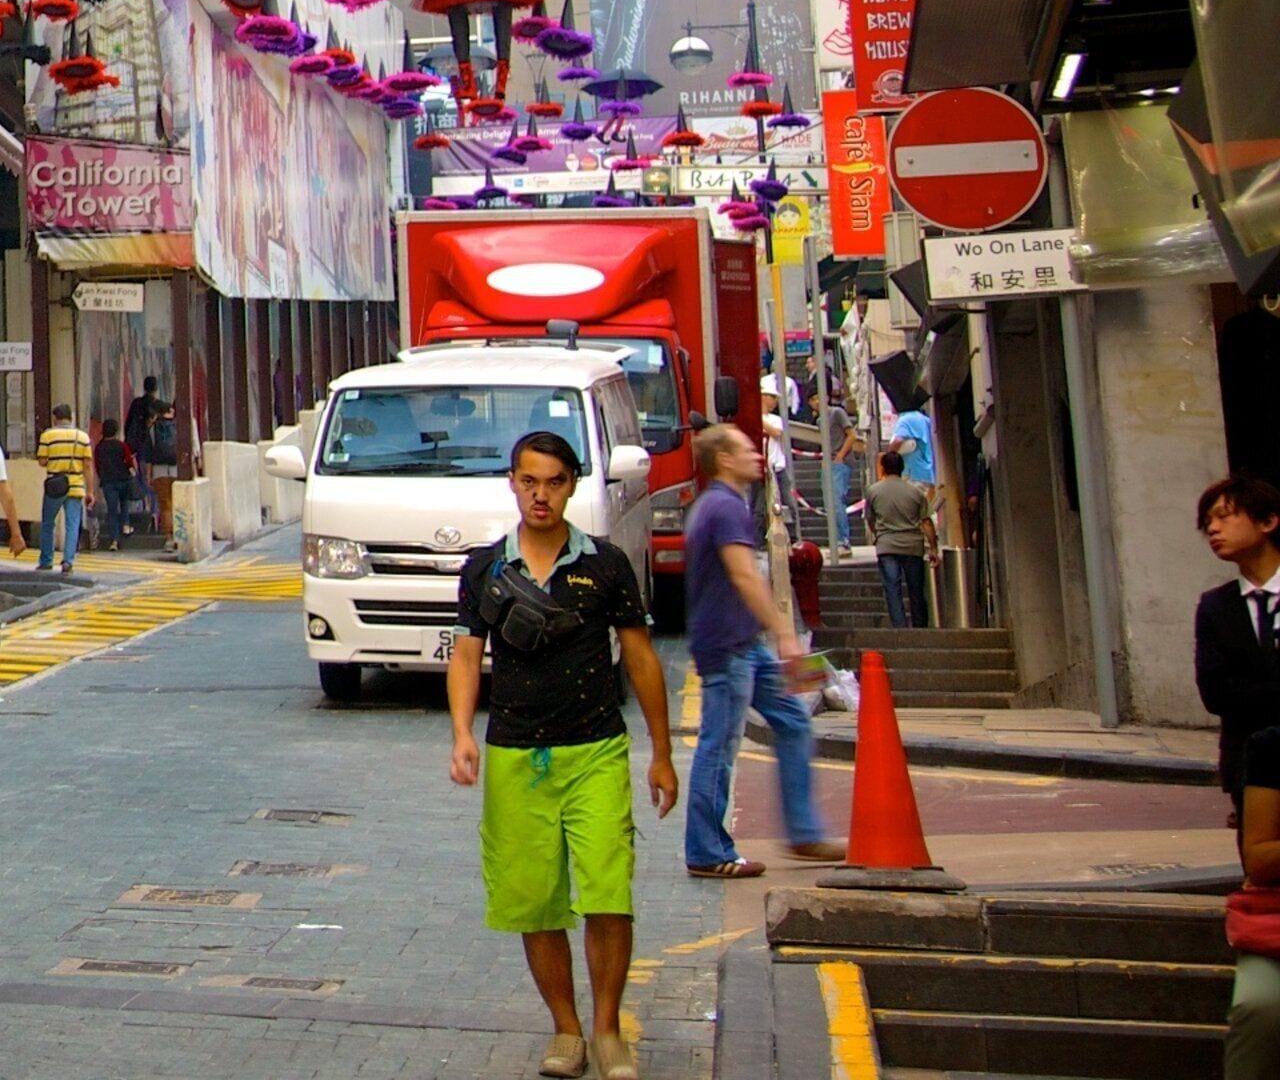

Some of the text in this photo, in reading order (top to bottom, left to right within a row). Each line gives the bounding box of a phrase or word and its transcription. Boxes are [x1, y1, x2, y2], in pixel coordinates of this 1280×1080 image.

[866, 11, 912, 31] BREW
[864, 40, 910, 61] HOUS
[30, 157, 184, 187] California
[690, 170, 730, 188] Bit
[62, 191, 158, 217] Tower
[849, 175, 876, 232] Siam
[954, 237, 1065, 257] Wo On Lane
[970, 266, 1058, 292] 和安里
[96, 287, 116, 296] Kwai
[116, 287, 138, 297] Fong
[10, 345, 30, 356] Fong
